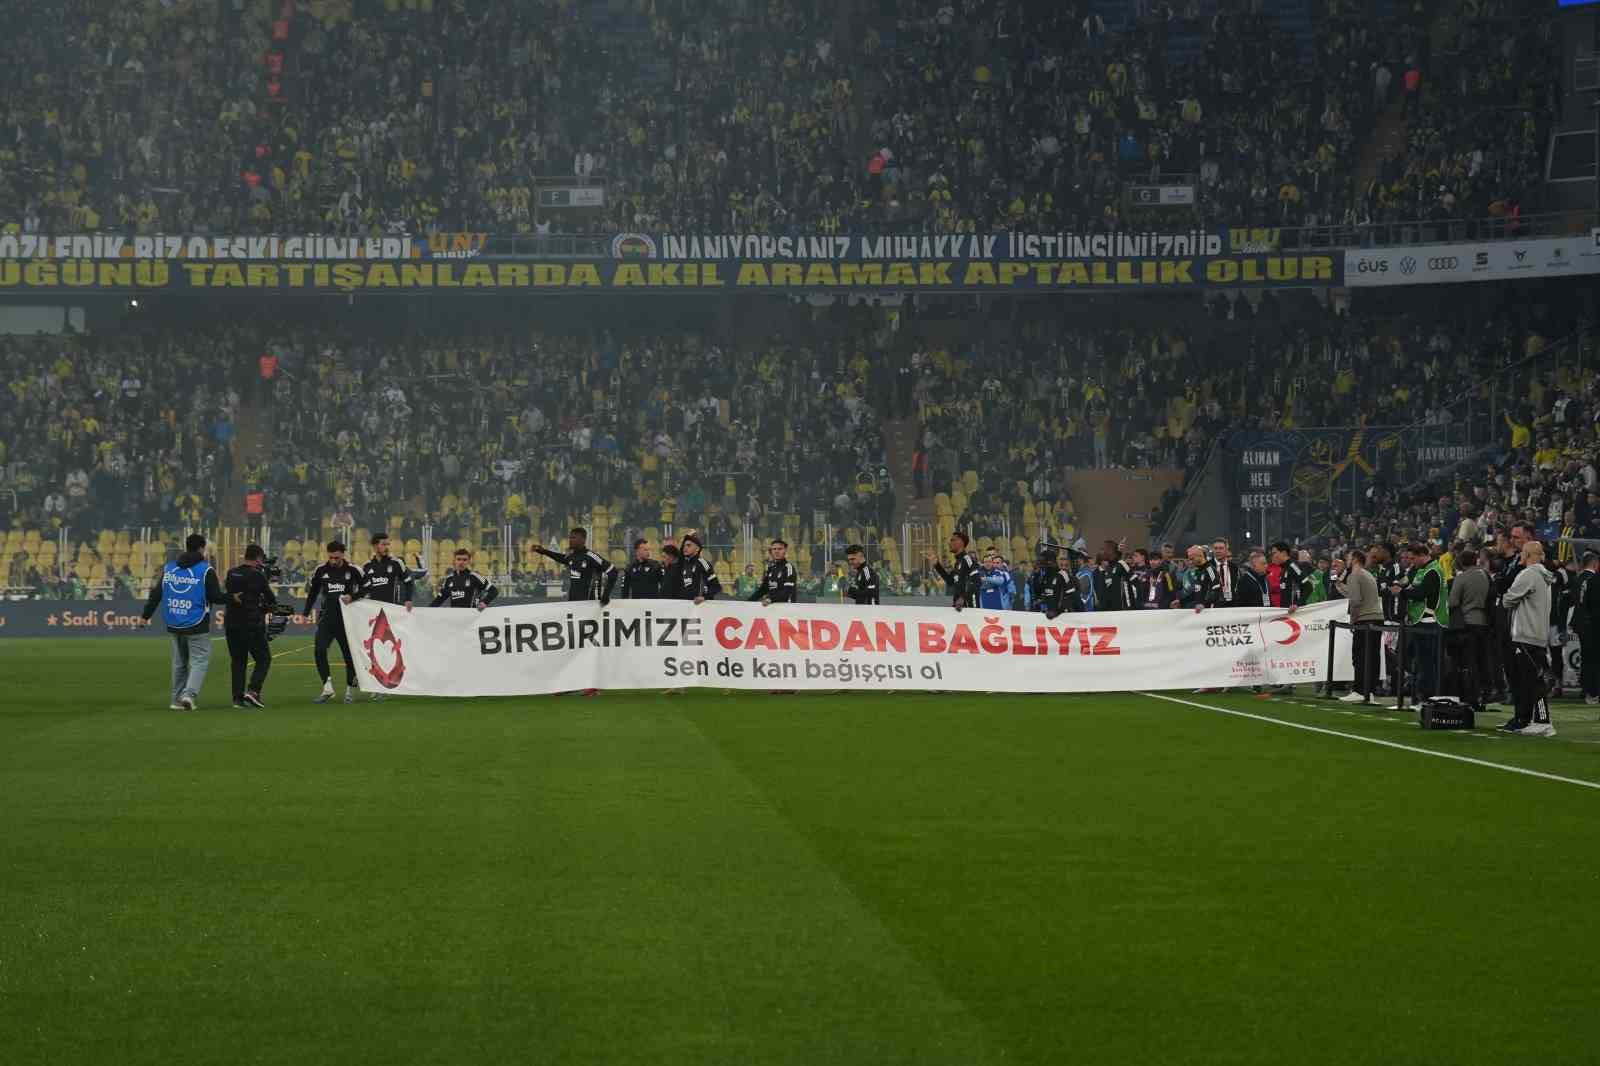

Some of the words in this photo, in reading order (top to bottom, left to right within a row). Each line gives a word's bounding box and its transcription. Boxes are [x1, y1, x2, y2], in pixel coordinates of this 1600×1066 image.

[1140, 190, 1152, 201] G
[183, 262, 602, 293] TARTIŞANLARDA
[612, 262, 725, 287] AKIL
[736, 261, 954, 286] ARAMAK
[963, 260, 1193, 286] APTALLIK
[1206, 255, 1334, 283] OLUR
[63, 610, 98, 626] Sadi
[478, 611, 703, 655] BİRBİRİMİZE
[715, 616, 907, 654] CANDAN
[918, 617, 1121, 656] BAĞLIYIZ
[1205, 623, 1251, 637] SENSİZ
[1205, 635, 1254, 649] OLMAZ
[663, 657, 709, 677] Sen
[716, 656, 745, 678] de
[752, 657, 798, 680] kan
[804, 658, 913, 683] bağışçısı
[920, 661, 943, 680] ol
[1270, 658, 1317, 669] kanver
